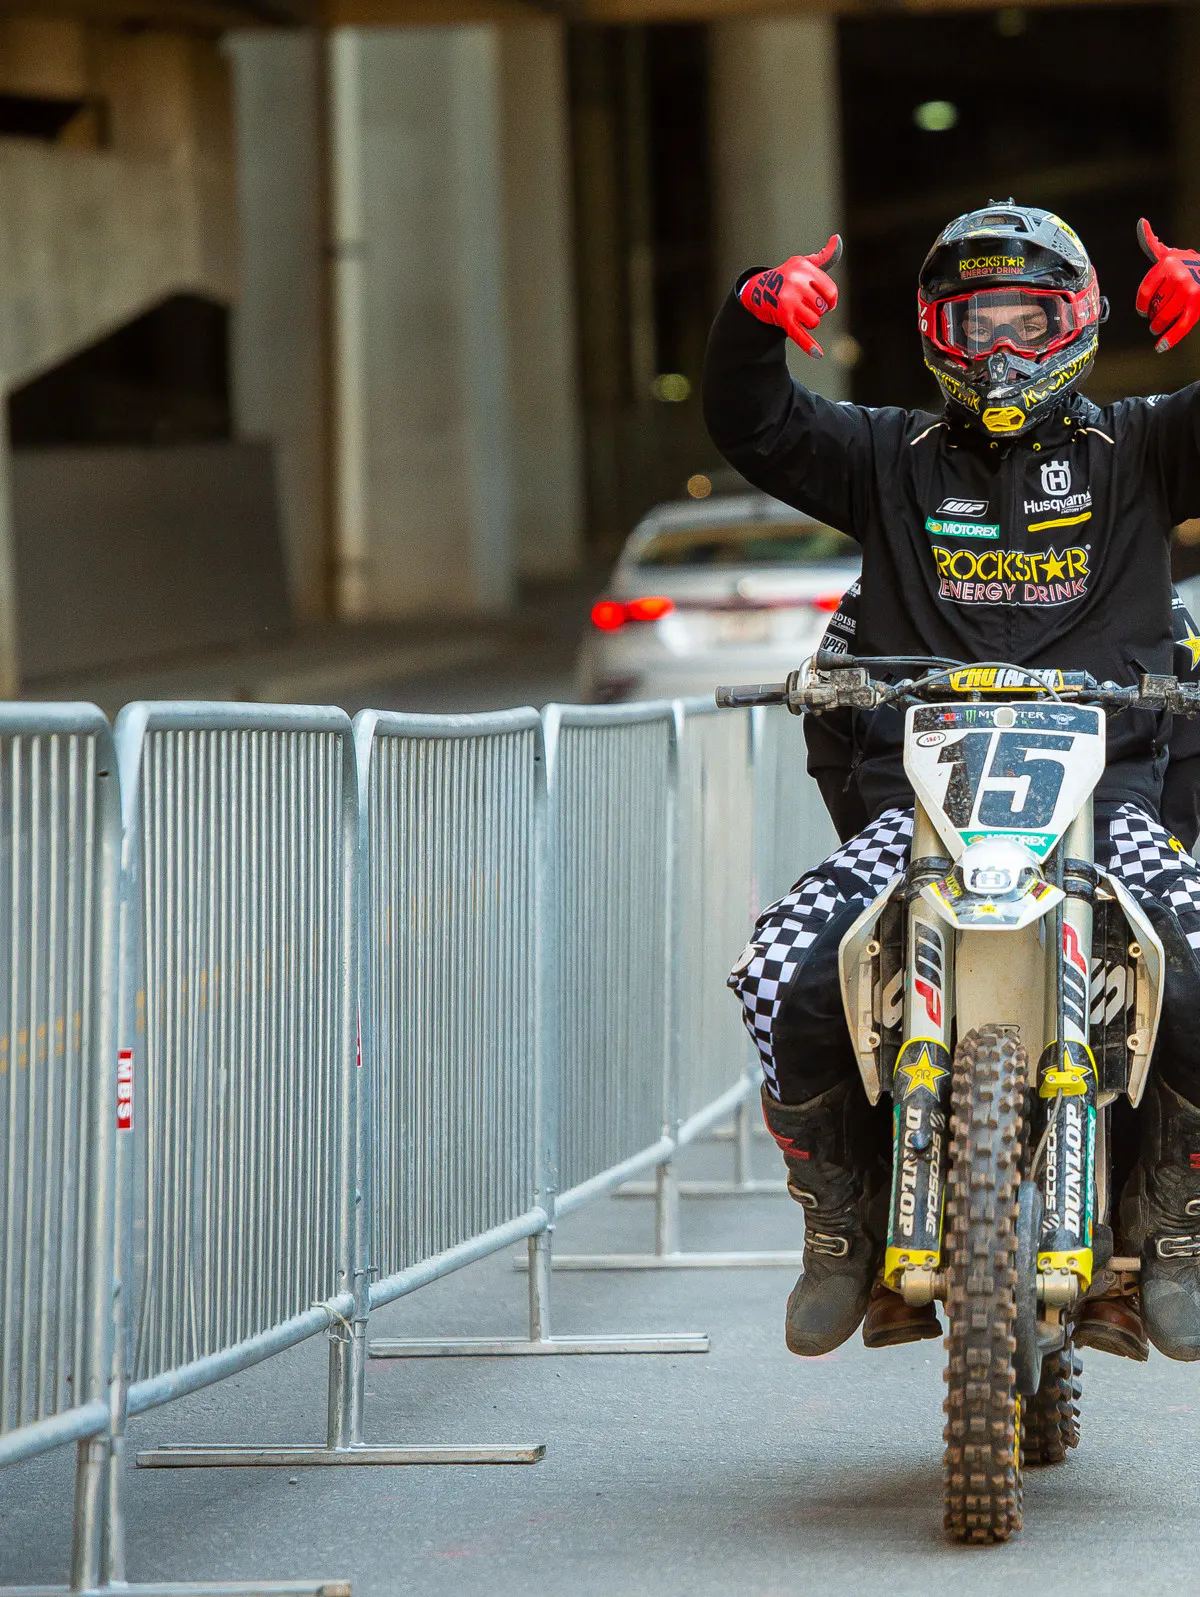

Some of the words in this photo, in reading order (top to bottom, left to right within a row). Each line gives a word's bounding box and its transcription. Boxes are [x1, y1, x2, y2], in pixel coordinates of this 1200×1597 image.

[961, 267, 994, 279] ENERGY
[996, 266, 1025, 275] DRINK
[943, 501, 985, 512] WP
[942, 523, 998, 537] MOTOREX
[941, 578, 1017, 601] ENERGY
[1024, 577, 1087, 602] DRINK
[978, 709, 1046, 720] MTER
[937, 731, 1076, 828] 15
[1064, 1103, 1083, 1239] DUNLOP
